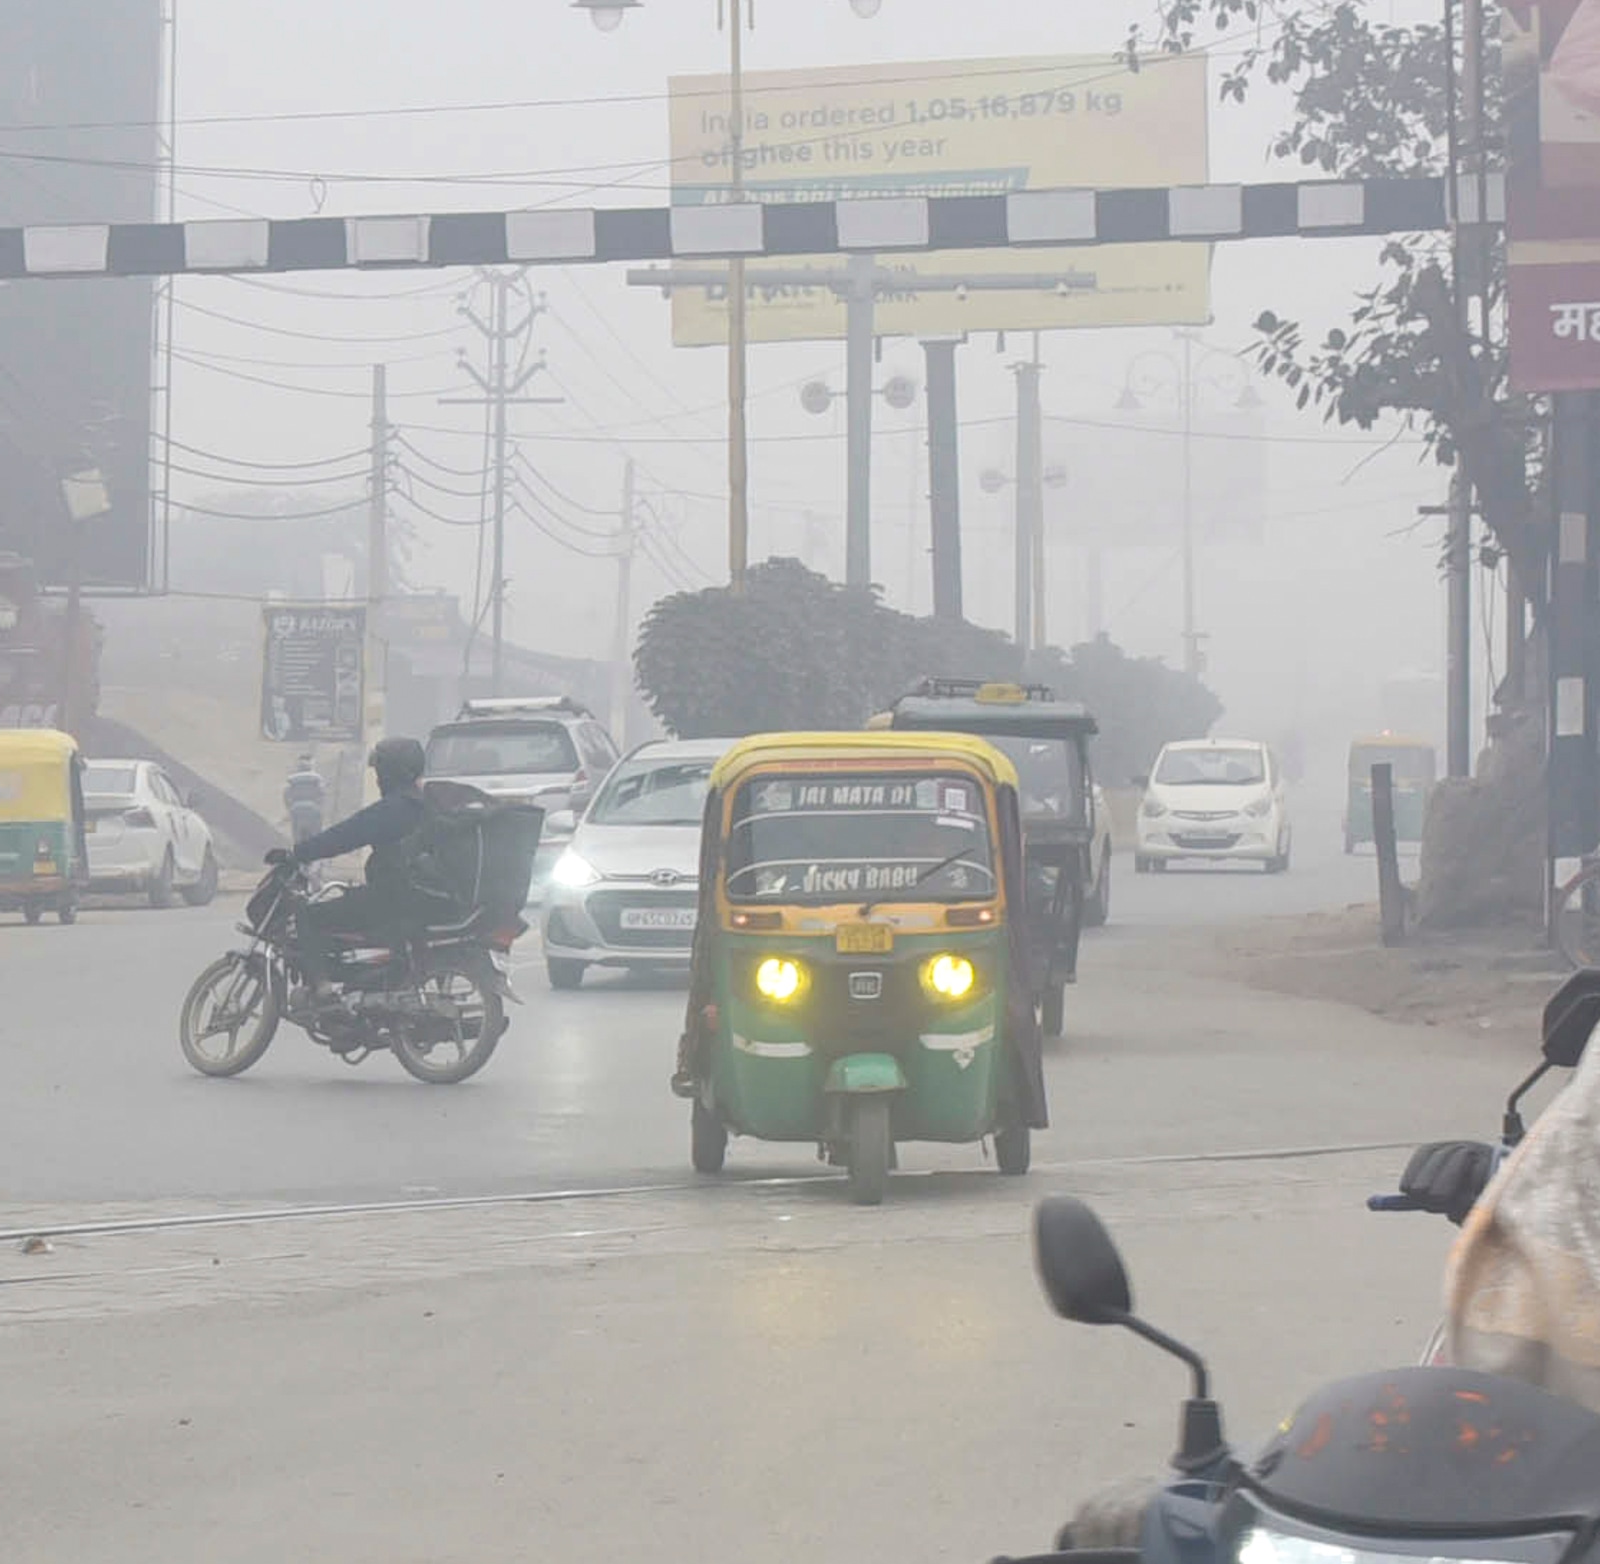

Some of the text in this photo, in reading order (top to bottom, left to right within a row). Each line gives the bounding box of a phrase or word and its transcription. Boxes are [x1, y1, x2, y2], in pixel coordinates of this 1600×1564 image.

[702, 107, 769, 133] Inia
[780, 102, 895, 130] ordered
[1086, 90, 1123, 116] kg
[824, 134, 873, 162] this
[883, 137, 948, 163] year
[832, 786, 885, 805] MATA
[891, 786, 913, 805] DI
